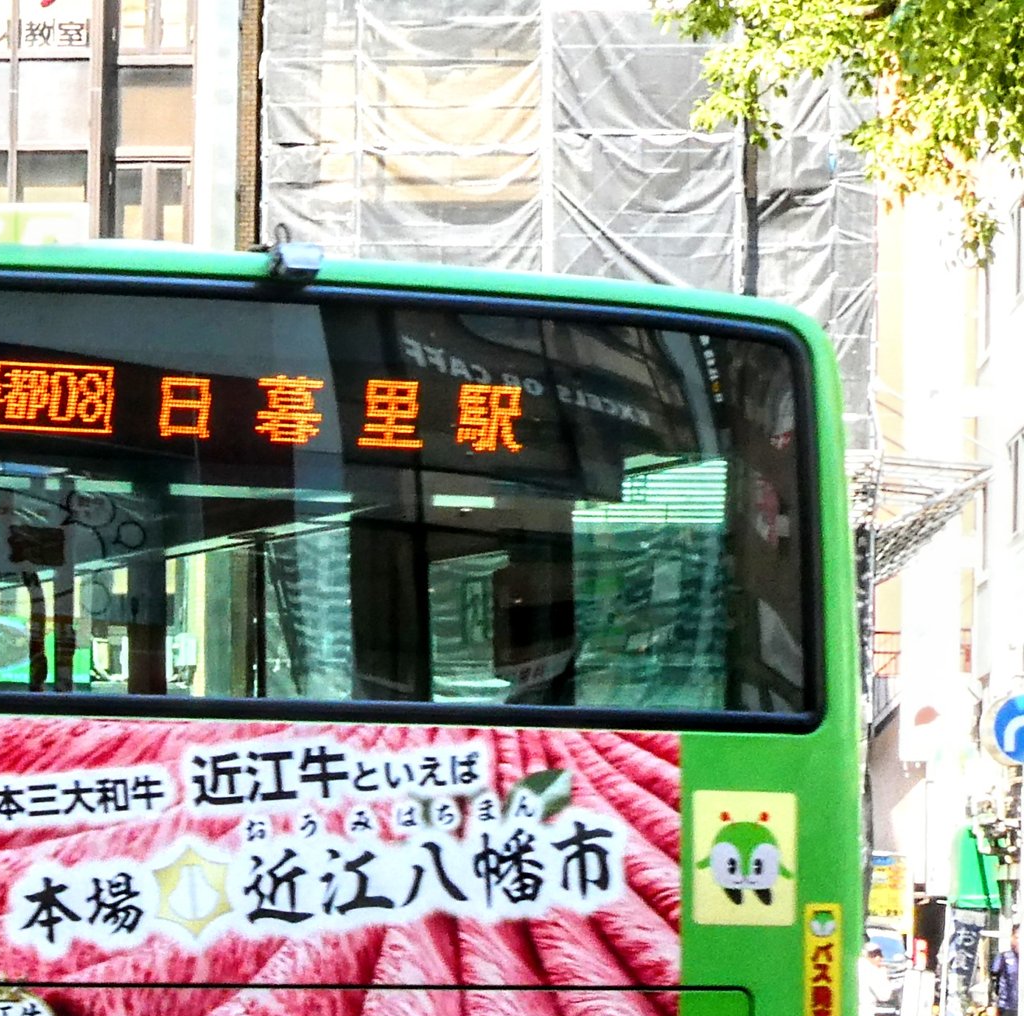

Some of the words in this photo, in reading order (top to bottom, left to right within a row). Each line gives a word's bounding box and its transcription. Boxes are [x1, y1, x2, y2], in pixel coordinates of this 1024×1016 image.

[4, 369, 107, 423] 都08
[158, 374, 523, 452] 日暮里駅
[191, 746, 480, 806] 近江牛といえば
[245, 797, 537, 841] おうみはちまん
[20, 871, 145, 943] 本場
[244, 820, 614, 924] 近江八幡市
